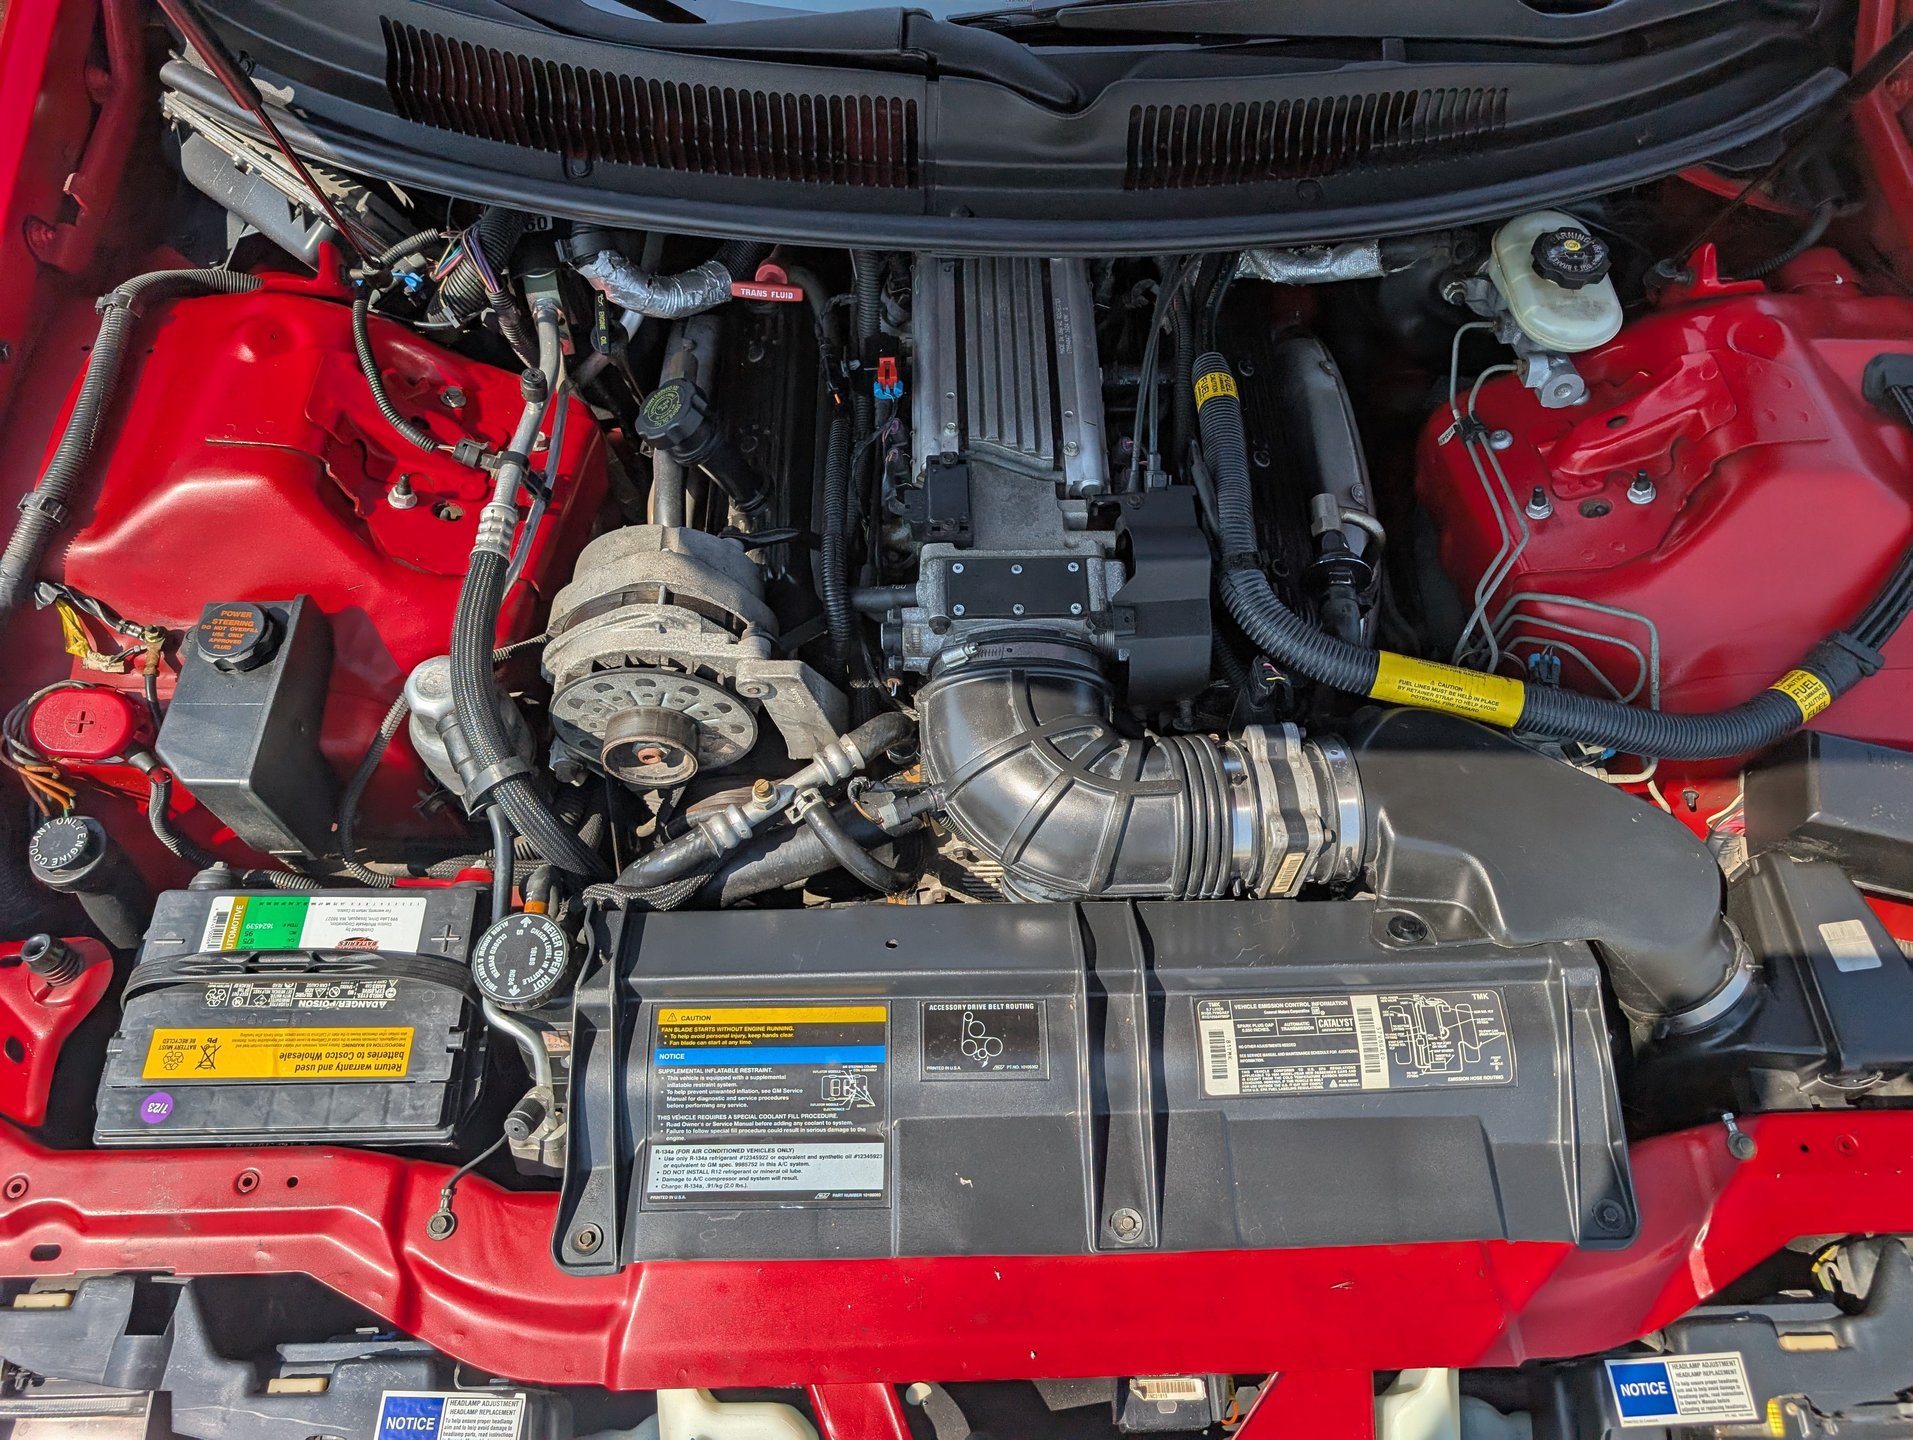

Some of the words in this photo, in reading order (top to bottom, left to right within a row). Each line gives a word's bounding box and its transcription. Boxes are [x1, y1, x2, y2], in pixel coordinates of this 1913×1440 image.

[1550, 232, 1591, 243] ARNING
[741, 288, 767, 297] TRANS
[771, 291, 793, 299] FLUID
[598, 311, 606, 330] ENGINE
[1201, 377, 1209, 397] FUEL
[221, 610, 252, 618] POWER
[212, 619, 254, 627] STEERING
[1438, 682, 1463, 692] CAUTION
[1783, 672, 1808, 690] CAUTION
[1792, 679, 1818, 698] FUEL
[1398, 679, 1412, 687] FUEL
[1414, 683, 1430, 691] LINES
[1431, 686, 1447, 694] MUST
[1457, 692, 1472, 700] HELD
[1481, 697, 1500, 706] PLACE
[1406, 688, 1434, 698] RETAINER
[1435, 694, 1454, 702] STRAP
[1464, 700, 1478, 708] HELP
[1479, 703, 1497, 712] AVOID
[1804, 690, 1827, 710] CAUTION
[56, 818, 84, 830] ONLY
[30, 822, 51, 865] COOLANT
[52, 833, 86, 866] ENGINE
[225, 905, 244, 949] UTOMOTIVE
[491, 921, 509, 936] ALIGN
[530, 927, 548, 942] CHECK
[541, 922, 562, 948] NEVER
[479, 935, 493, 957] ARROW
[489, 933, 508, 955] CLOSED
[544, 942, 552, 959] LEVEL
[488, 955, 501, 979] SYSTEM
[542, 961, 550, 969] IN
[548, 950, 563, 975] OPEN
[478, 964, 487, 980] VENT
[522, 968, 545, 985] BOTTLE
[484, 977, 498, 992] TUBE
[533, 975, 551, 992] HOT
[298, 1000, 378, 1008] DANGER/POISON
[1318, 1018, 1353, 1028] CATALYST
[279, 1052, 322, 1061] Wholesale
[325, 1052, 354, 1060] Costco
[356, 1052, 365, 1060] to
[367, 1052, 404, 1060] batteries
[295, 1064, 316, 1073] used
[317, 1064, 334, 1072] and
[335, 1064, 372, 1072] warranty
[374, 1064, 402, 1072] Return
[148, 1102, 169, 1113] 7/23
[1702, 1360, 1736, 1368] ADJUSTMENT
[1620, 1381, 1668, 1397] NOTICE
[386, 1417, 435, 1430] NOTICE
